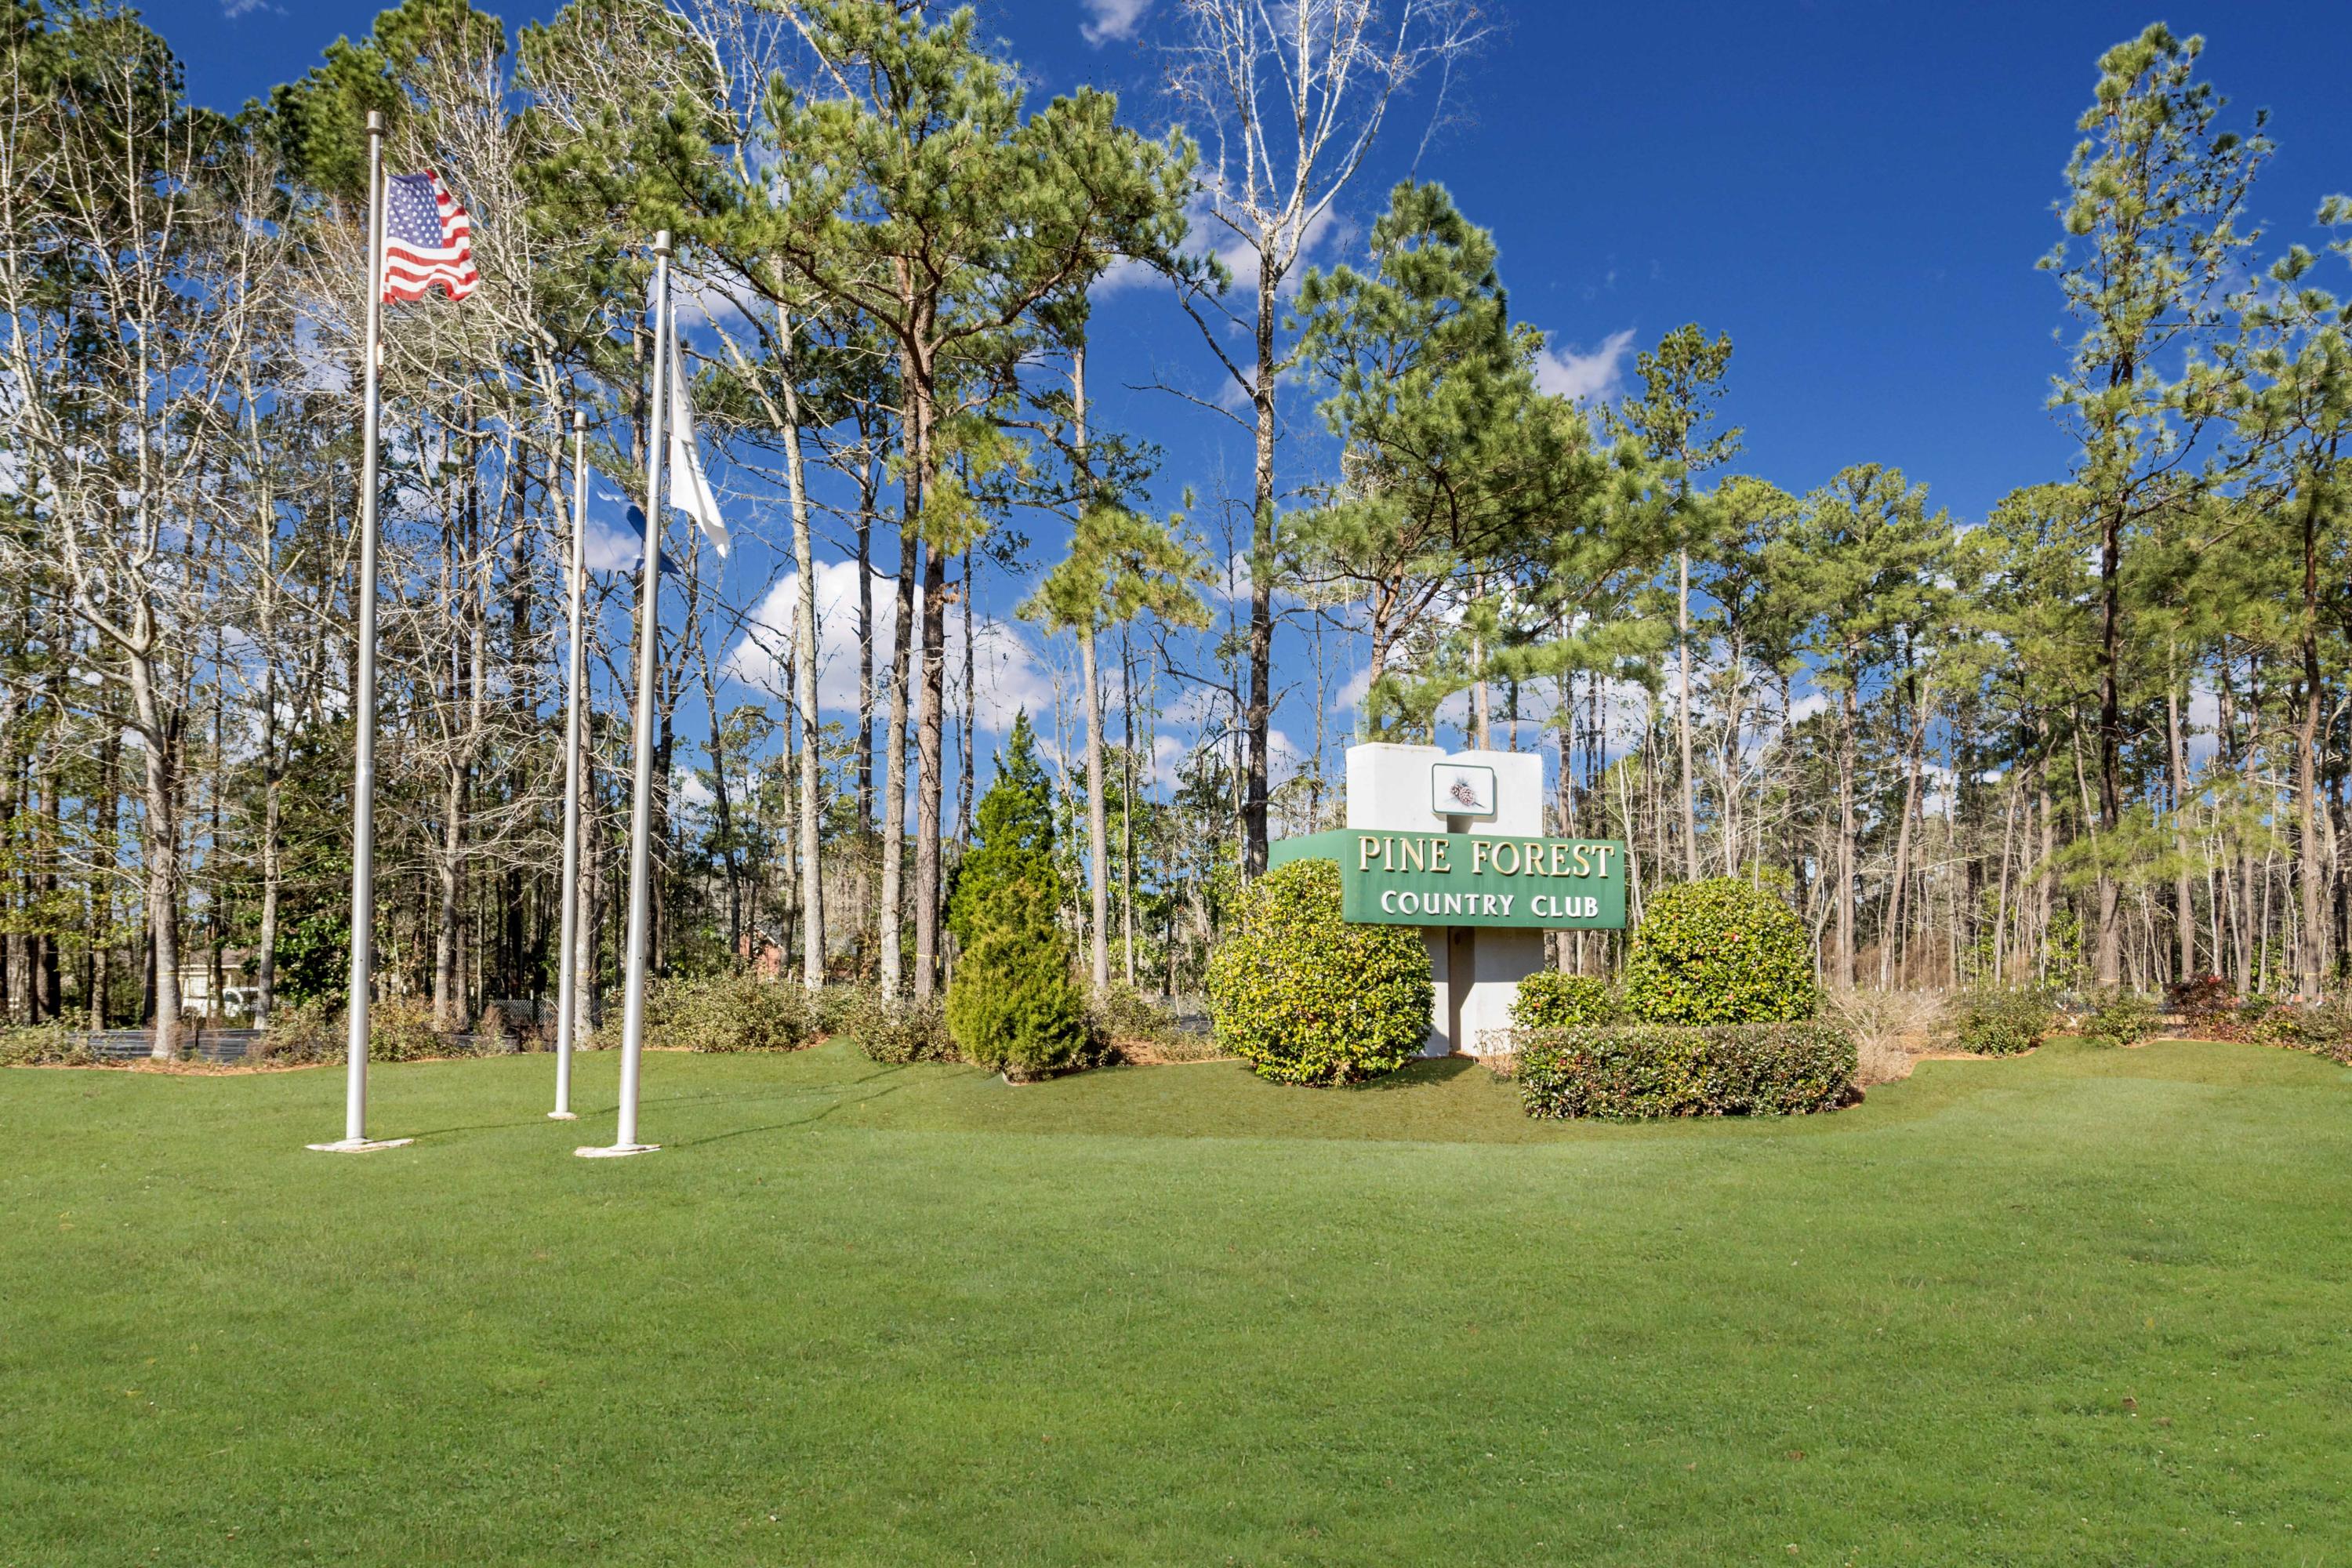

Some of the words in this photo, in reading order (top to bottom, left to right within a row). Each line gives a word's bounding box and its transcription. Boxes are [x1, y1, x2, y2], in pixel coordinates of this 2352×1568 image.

[1359, 836, 1451, 873] PINE
[1472, 840, 1614, 878] FOREST
[1381, 890, 1514, 916] COUNTRY
[1531, 895, 1599, 917] CLUB
